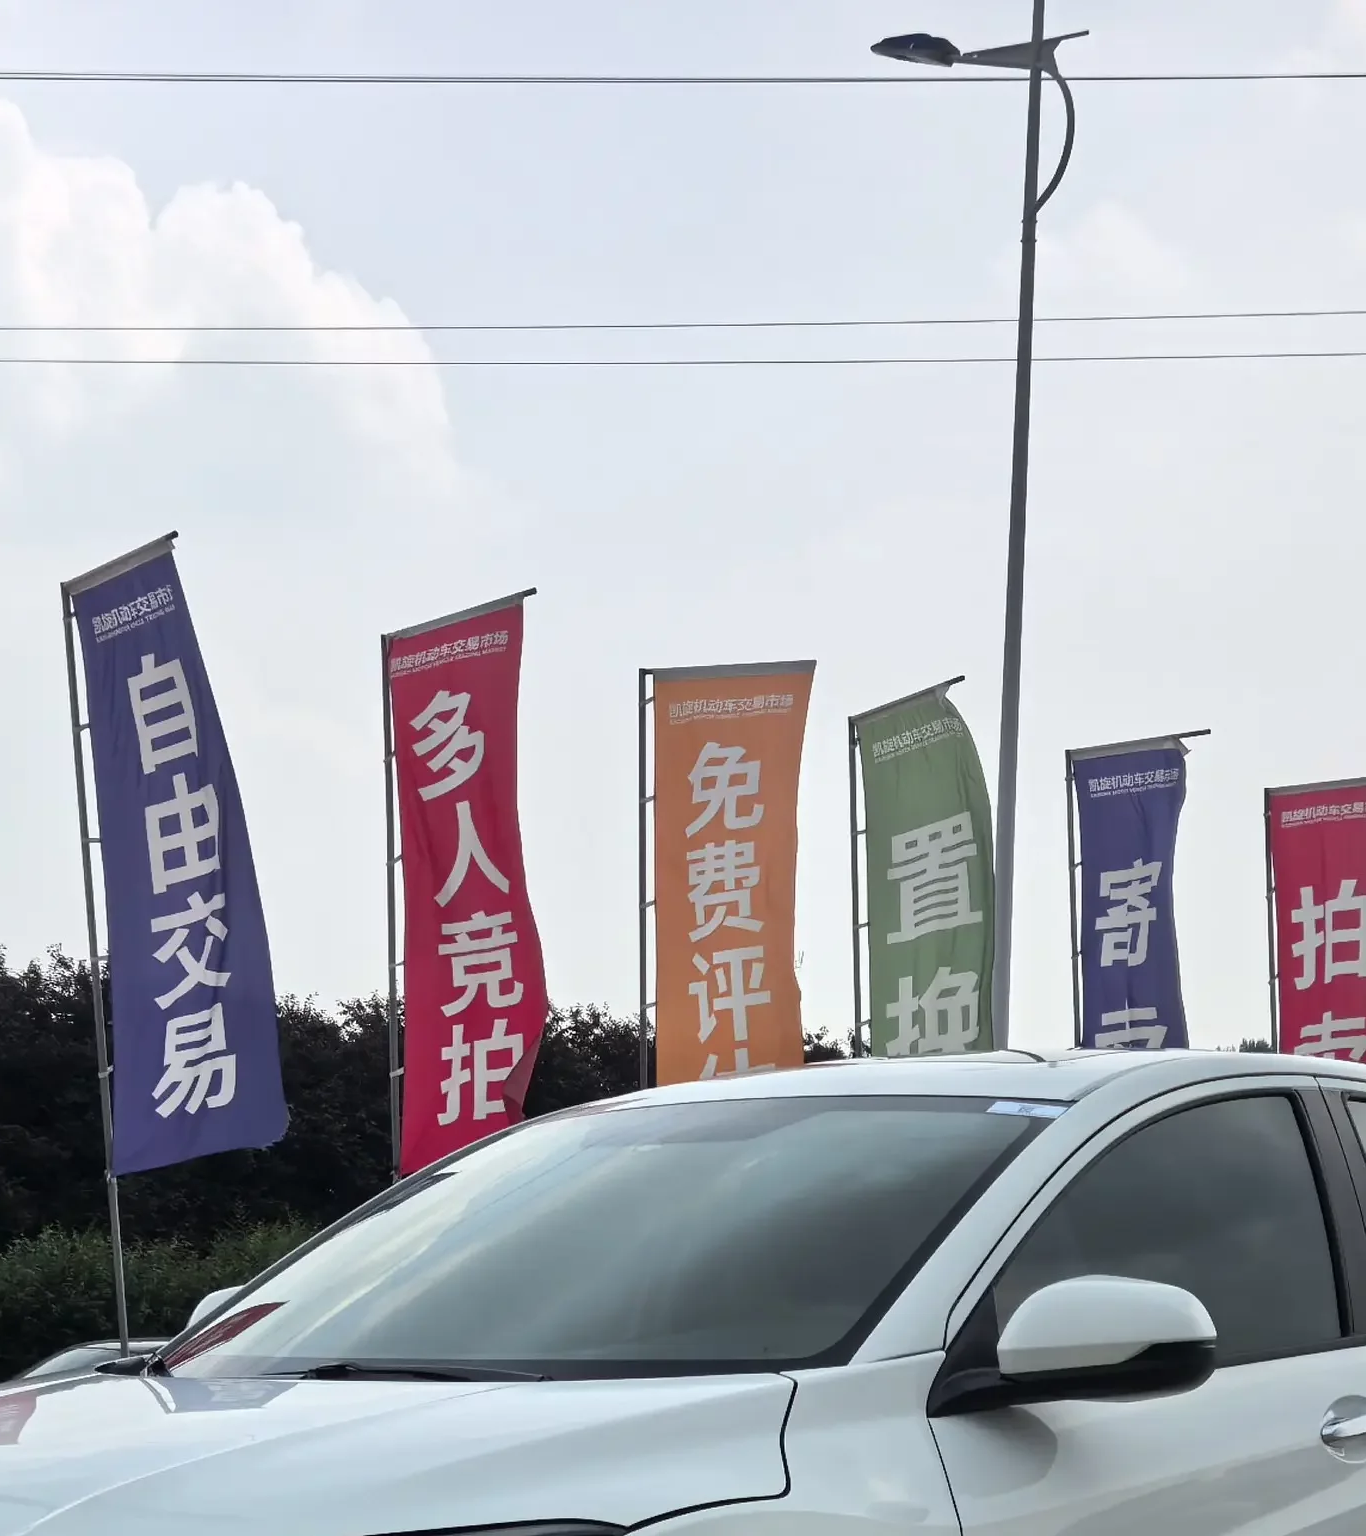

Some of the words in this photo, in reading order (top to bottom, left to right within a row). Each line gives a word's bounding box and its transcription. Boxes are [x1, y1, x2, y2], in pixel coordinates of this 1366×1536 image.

[127, 653, 237, 1119] 自由交易
[409, 689, 525, 1127] 多人竞拍
